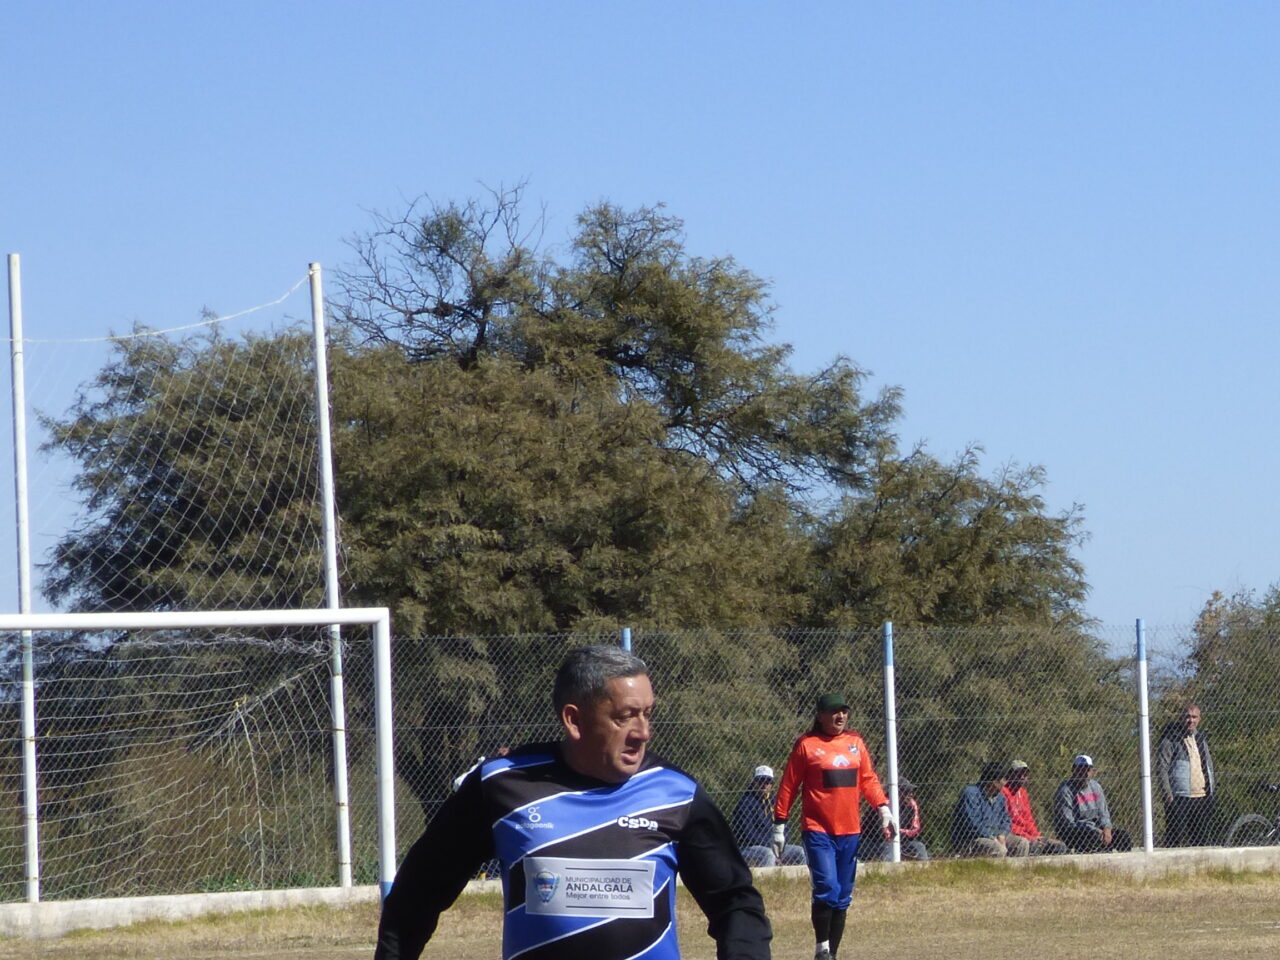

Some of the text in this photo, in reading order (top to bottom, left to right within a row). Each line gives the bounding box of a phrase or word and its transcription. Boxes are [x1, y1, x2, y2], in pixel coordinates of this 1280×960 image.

[618, 816, 659, 832] CSDA
[565, 876, 621, 884] MUNICIPALIDAD
[566, 882, 634, 893] ANDALGALÁ
[566, 892, 588, 900] Mejor
